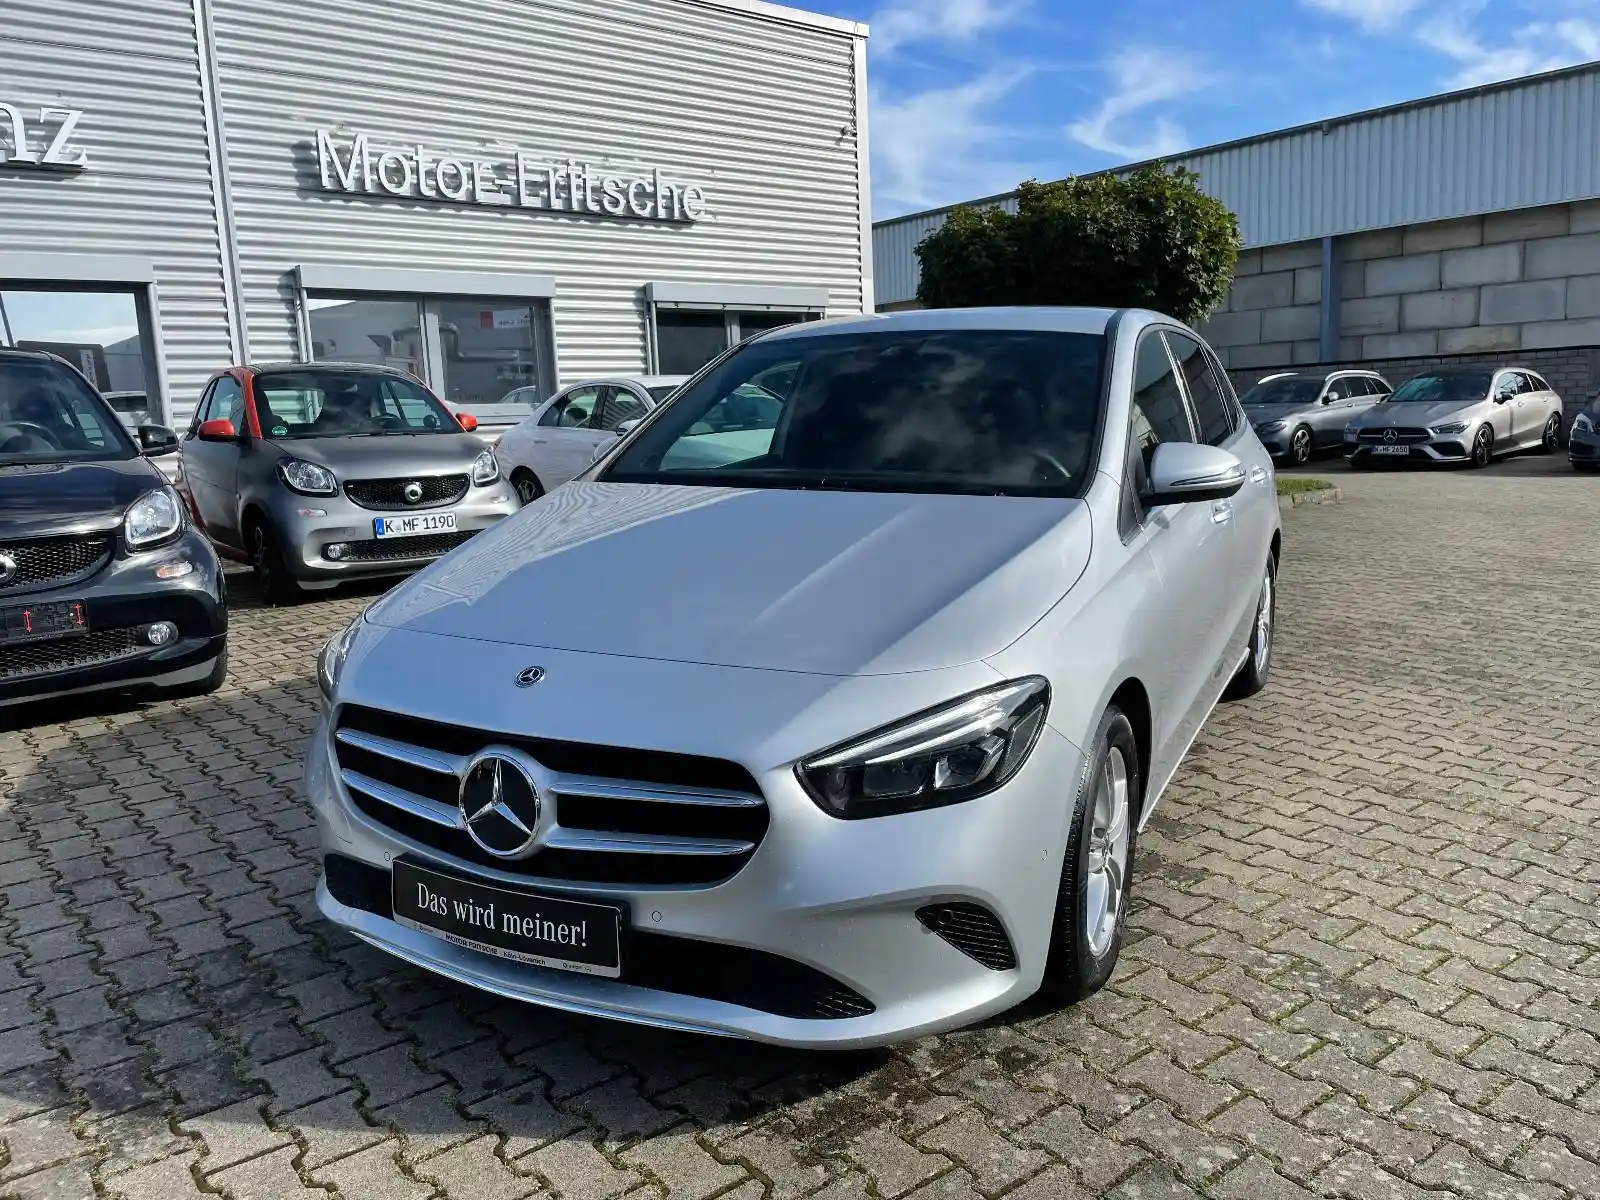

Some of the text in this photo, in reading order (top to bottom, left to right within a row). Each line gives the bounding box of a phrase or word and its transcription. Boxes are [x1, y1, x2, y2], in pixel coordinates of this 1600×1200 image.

[385, 515, 454, 533] K MF 1190
[416, 882, 588, 948] Das wird meiner!
